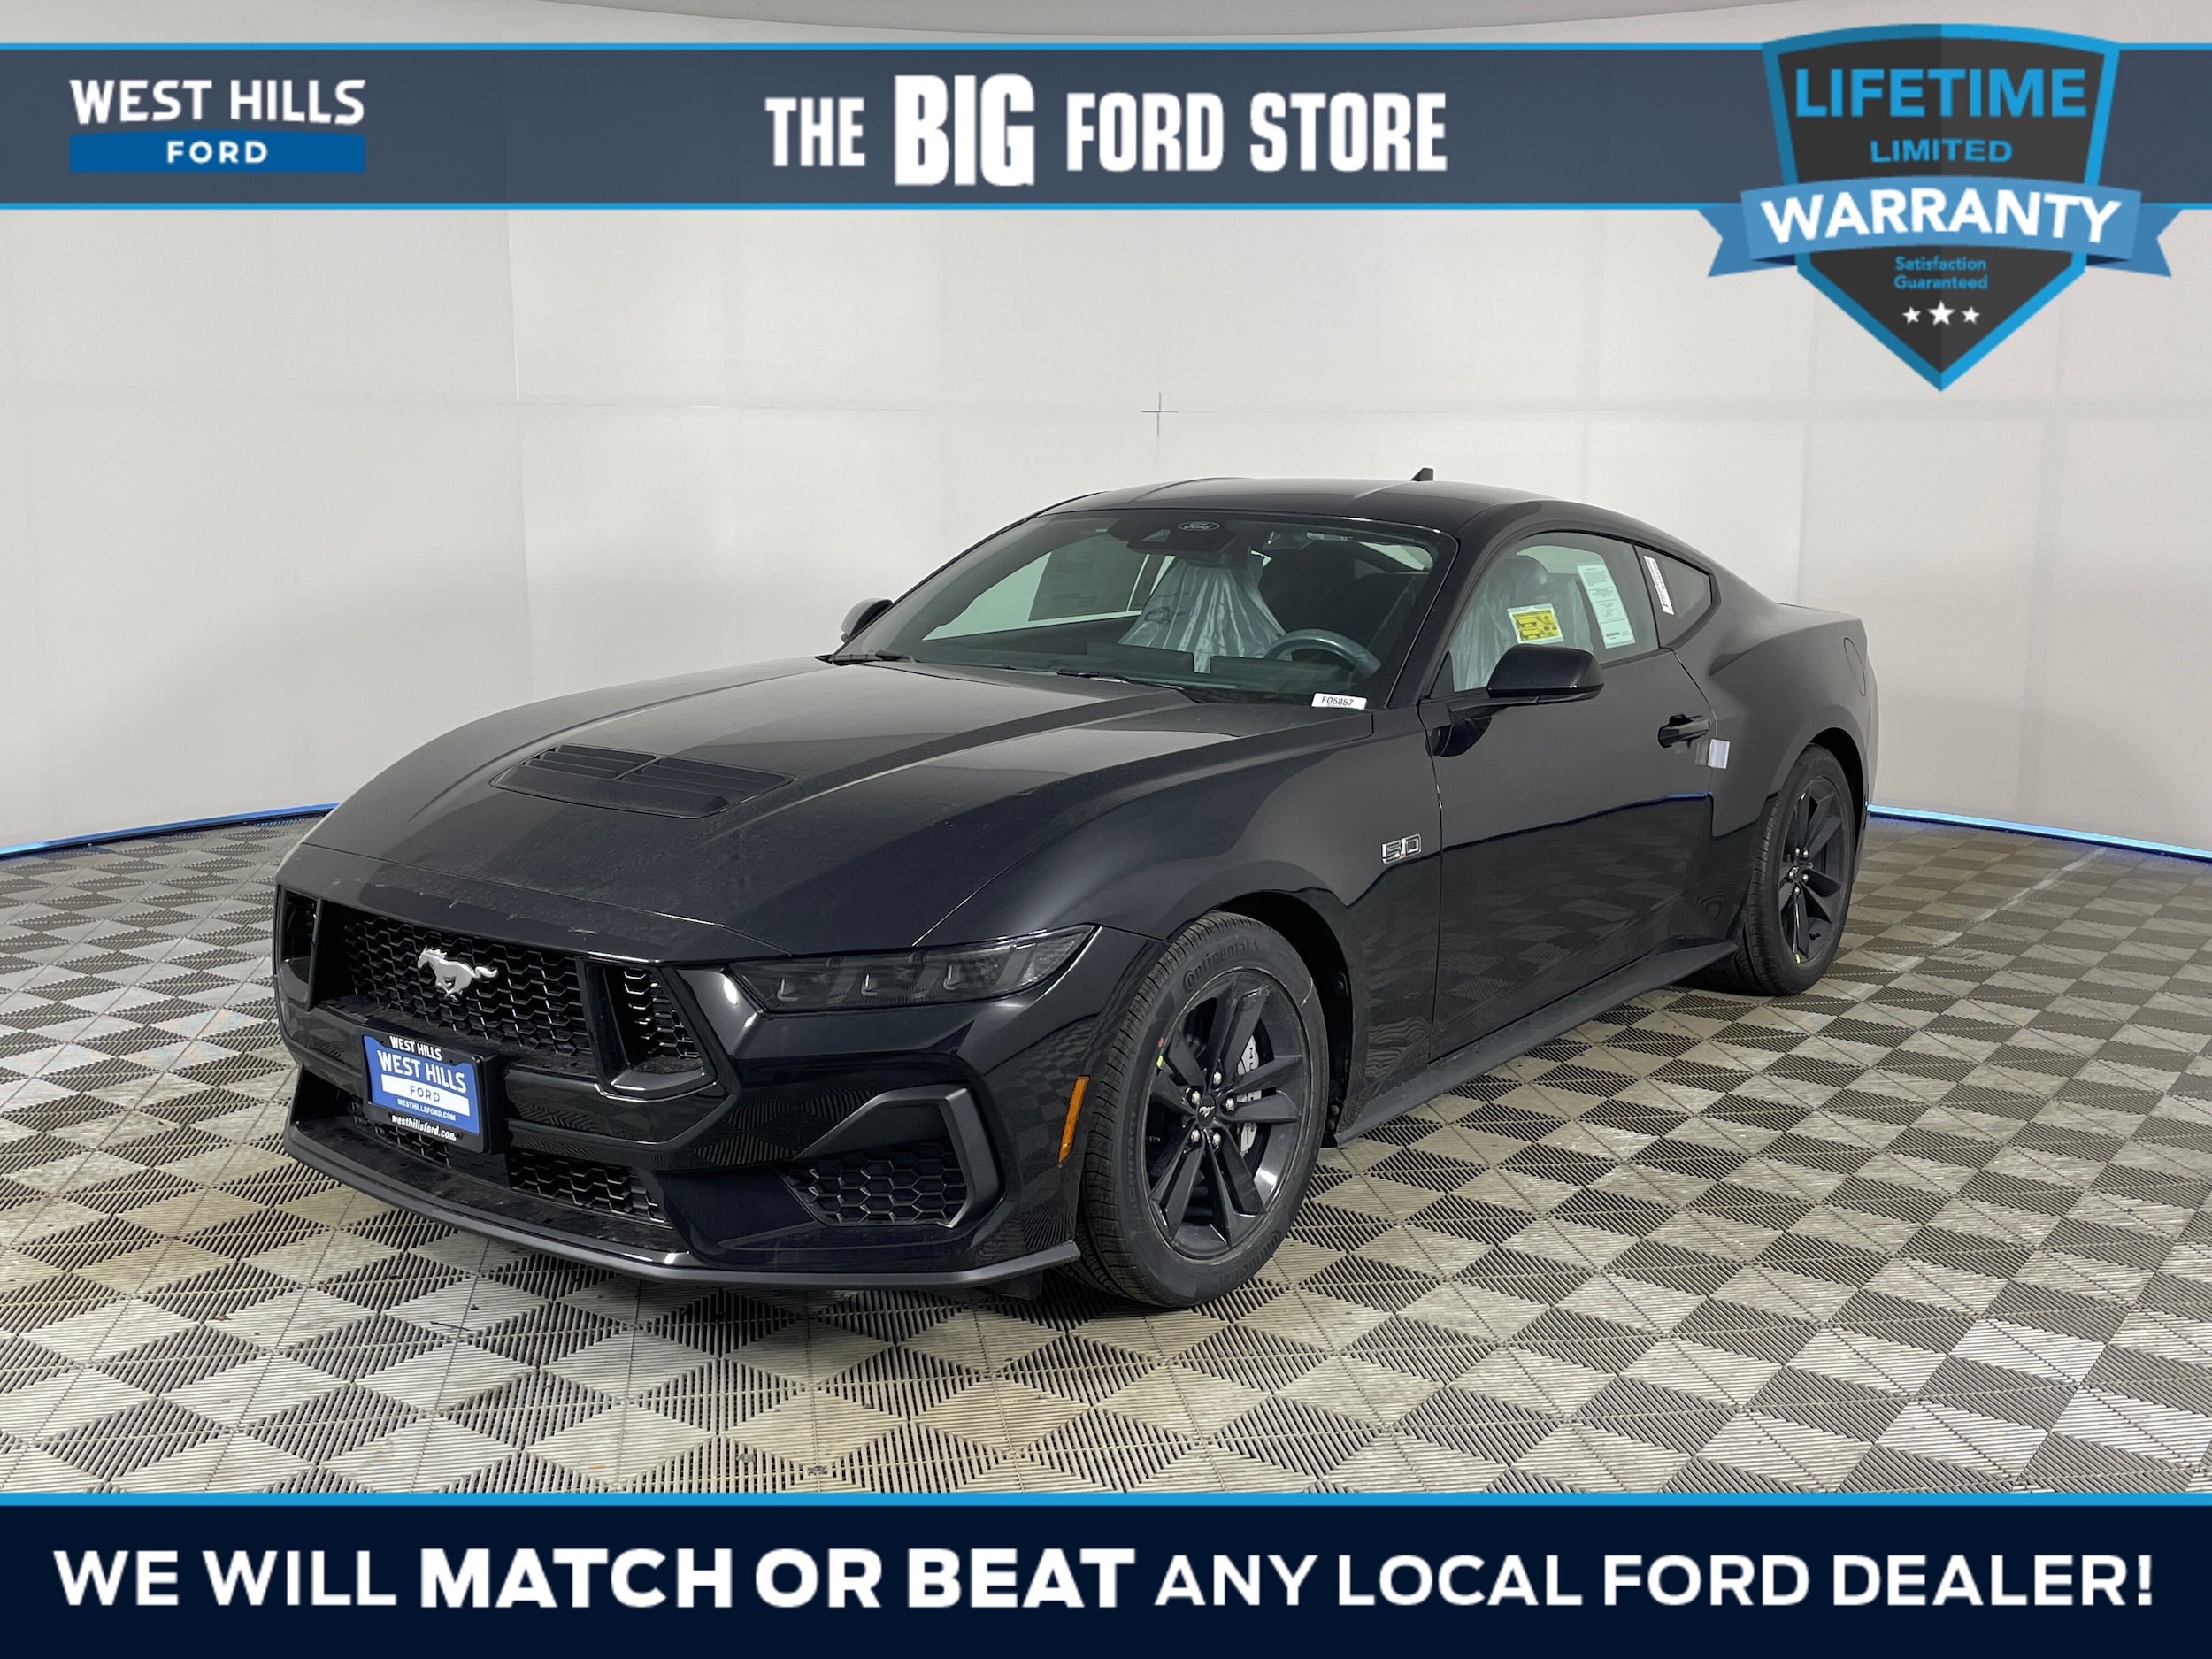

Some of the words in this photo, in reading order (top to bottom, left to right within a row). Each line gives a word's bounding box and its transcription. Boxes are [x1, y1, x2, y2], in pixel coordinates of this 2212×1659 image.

[389, 1035, 416, 1052] WEST
[417, 1042, 442, 1061] HILLS
[377, 1050, 420, 1078] WEST
[425, 1062, 467, 1094] HILLS
[410, 1085, 441, 1102] FORD
[397, 1098, 457, 1121] WESTHILLSFORD.COM
